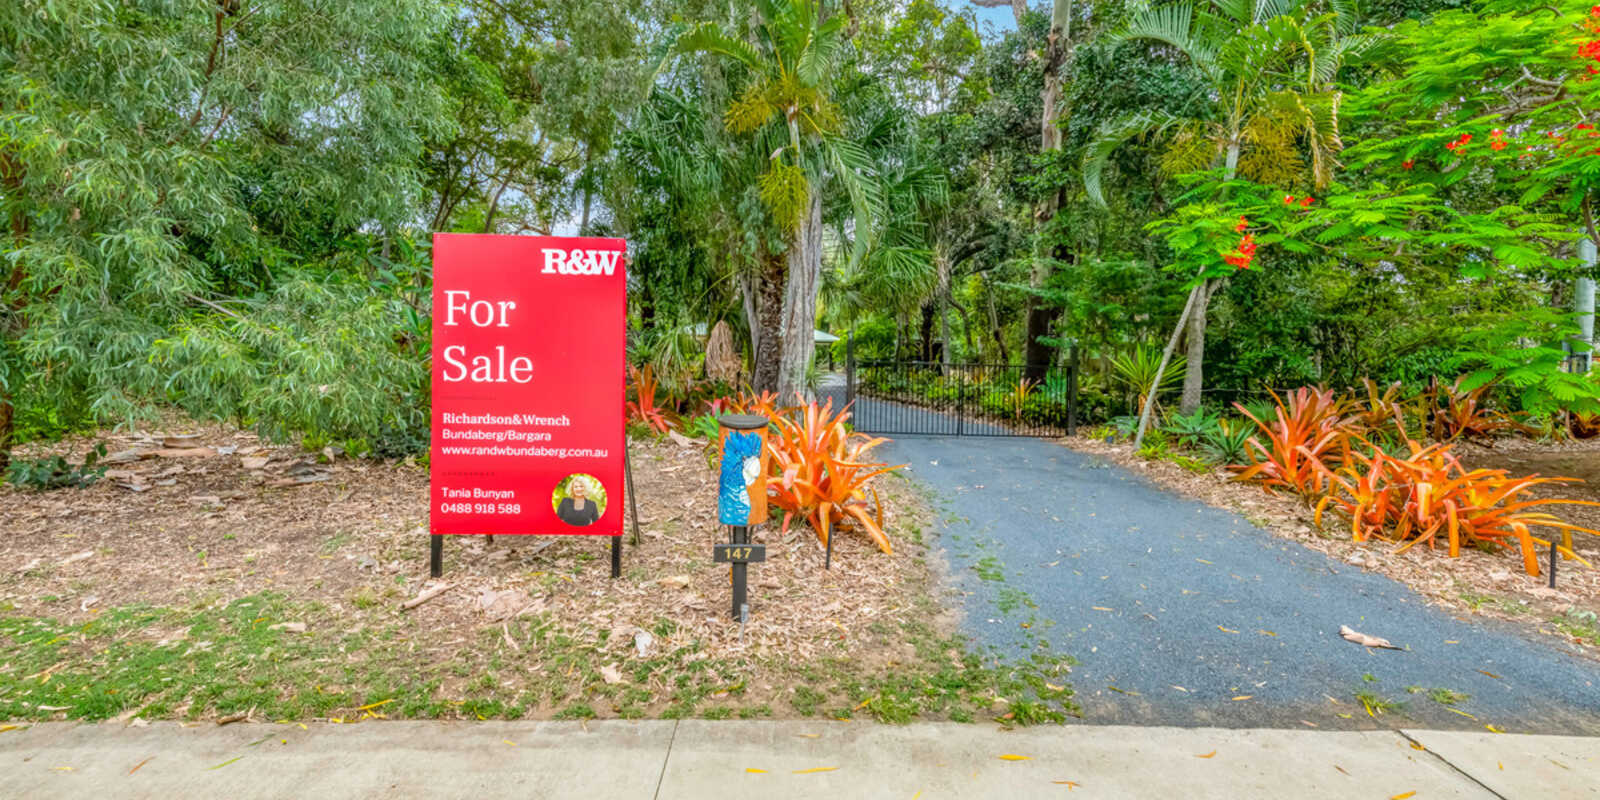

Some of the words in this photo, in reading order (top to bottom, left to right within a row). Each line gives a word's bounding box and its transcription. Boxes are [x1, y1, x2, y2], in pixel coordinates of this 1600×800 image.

[540, 248, 621, 275] R&W
[443, 290, 516, 327] For
[443, 345, 533, 383] Sale
[442, 429, 551, 442] Bundaberg/Bargara
[441, 446, 608, 458] www.randwbundaberg.com.au
[441, 487, 471, 498] Tania
[473, 488, 514, 500] Bunyan
[441, 503, 472, 514] 0488
[474, 503, 495, 514] 918
[497, 503, 521, 514] 588
[725, 548, 752, 559] 147
